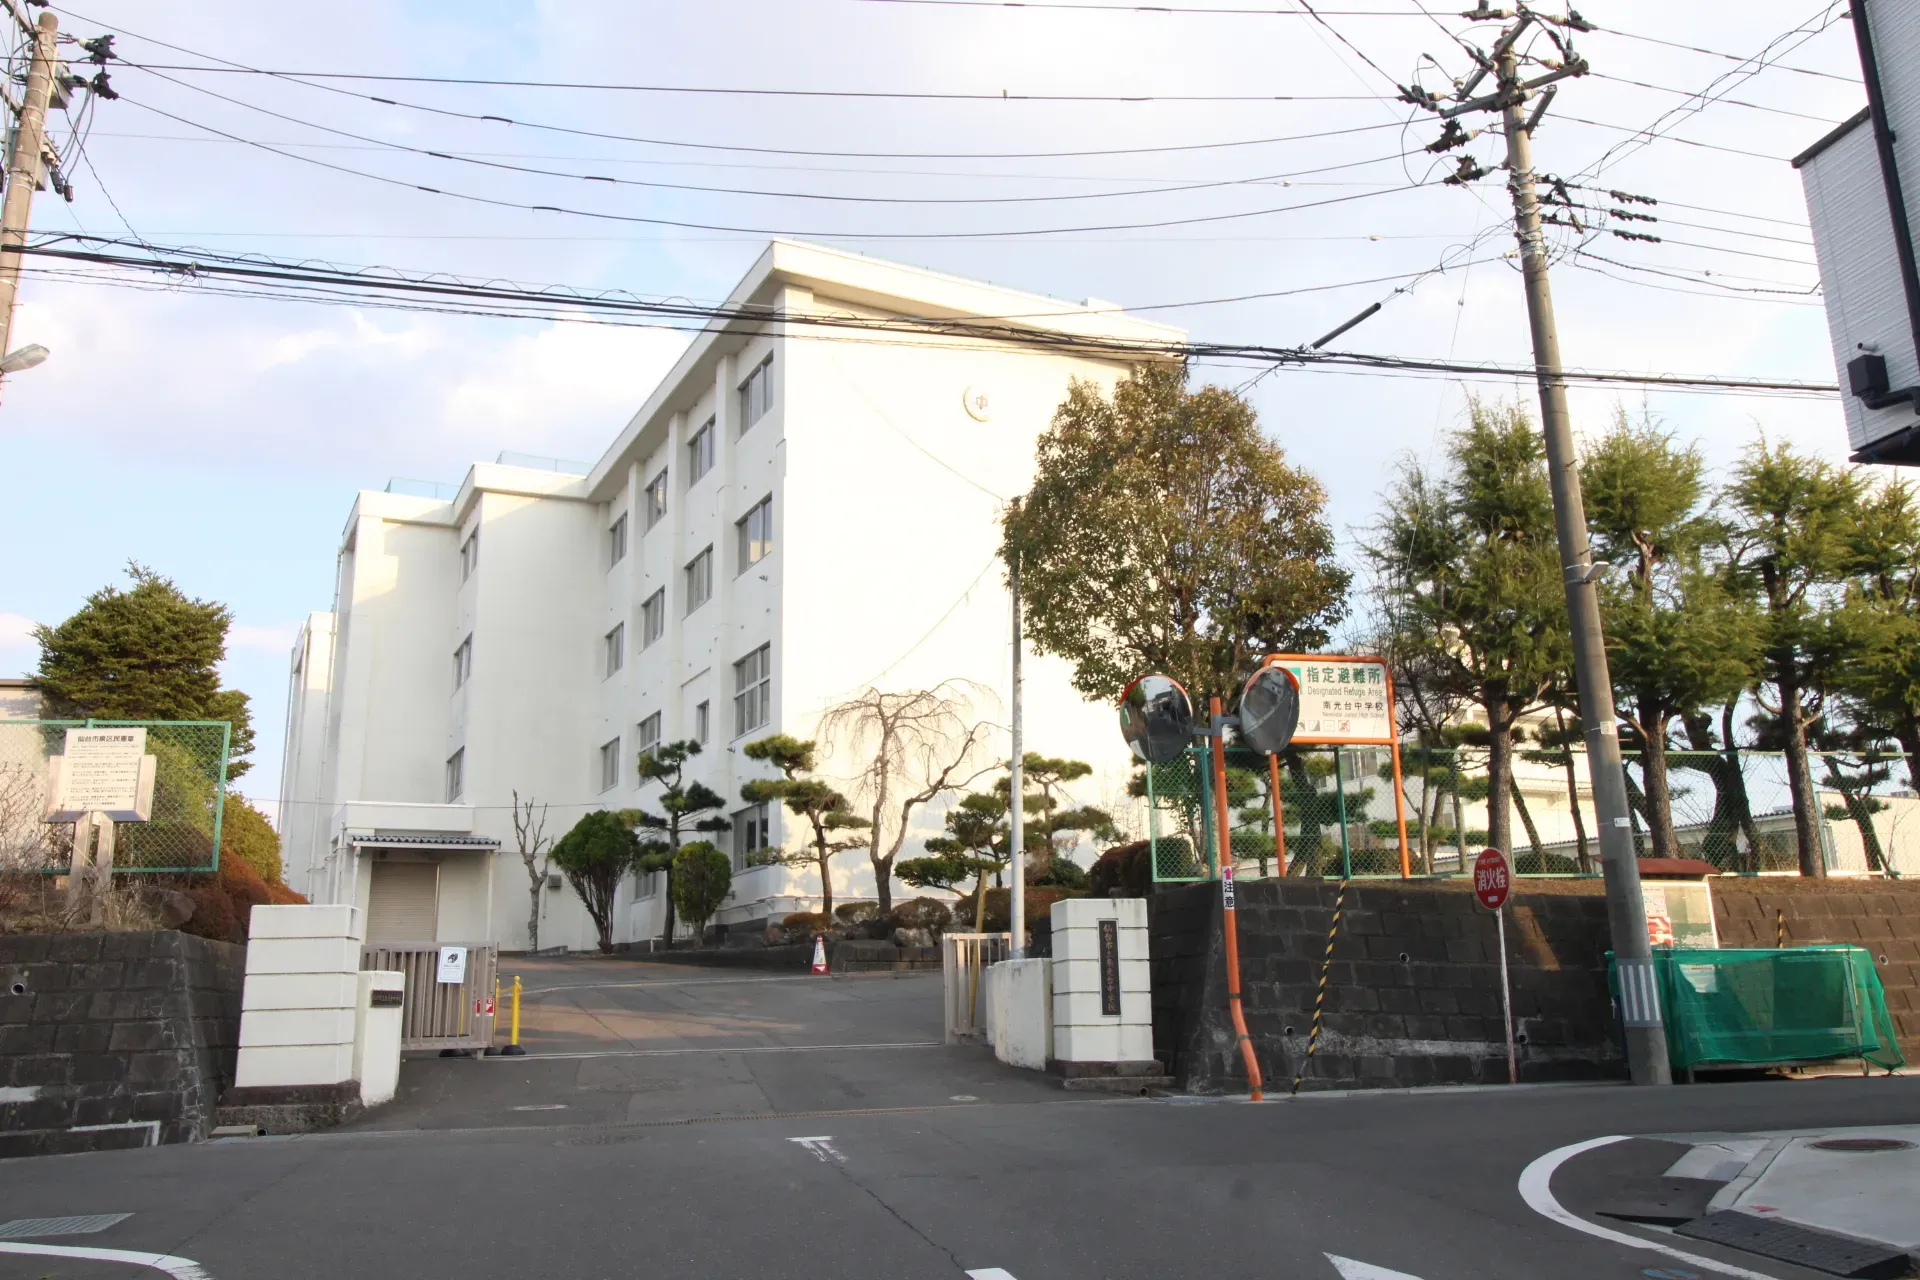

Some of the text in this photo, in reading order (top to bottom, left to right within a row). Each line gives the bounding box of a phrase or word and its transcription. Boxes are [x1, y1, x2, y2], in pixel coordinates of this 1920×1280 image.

[1306, 666, 1380, 684] 指定避難所
[1307, 686, 1383, 698] Designated Refuge Area
[1323, 701, 1384, 711] 南光台中学校
[1477, 866, 1506, 891] 消火栓
[1224, 881, 1234, 908] 注意
